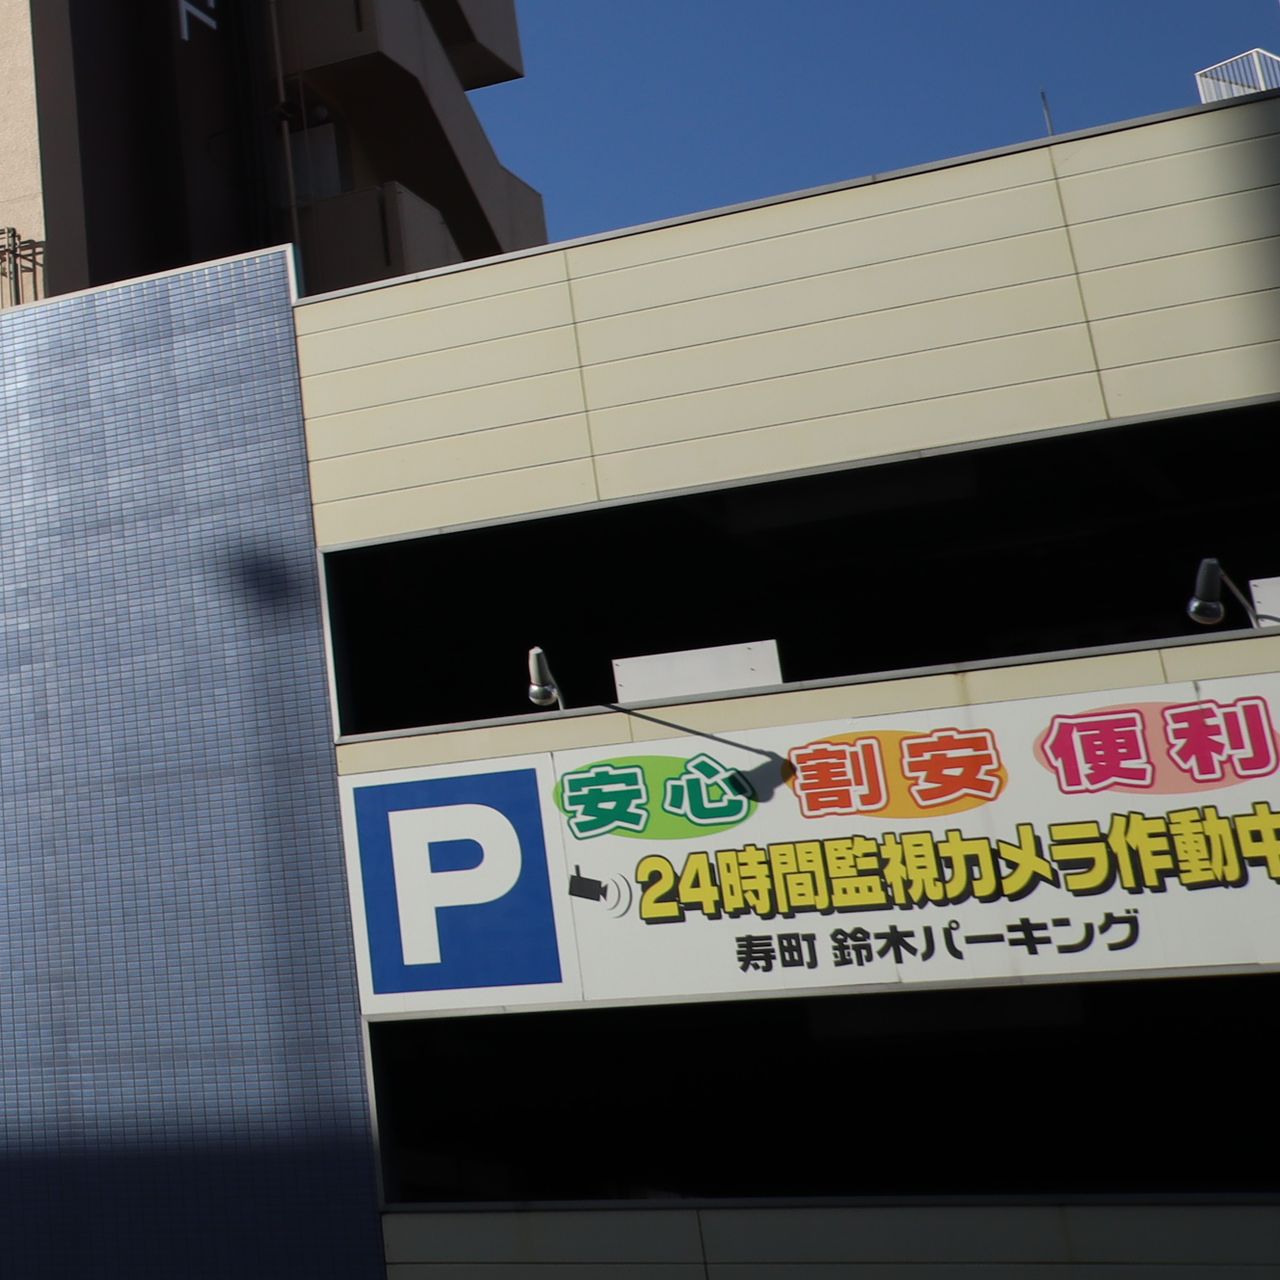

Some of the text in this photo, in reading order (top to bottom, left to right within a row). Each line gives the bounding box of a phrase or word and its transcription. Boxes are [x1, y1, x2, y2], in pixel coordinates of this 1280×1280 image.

[565, 696, 1278, 839] 安心 割安 便利
[387, 802, 523, 966] P
[636, 800, 1280, 923] 24時間監視カメラ作動中
[736, 907, 1141, 974] 寿町 鈴木パーキング
